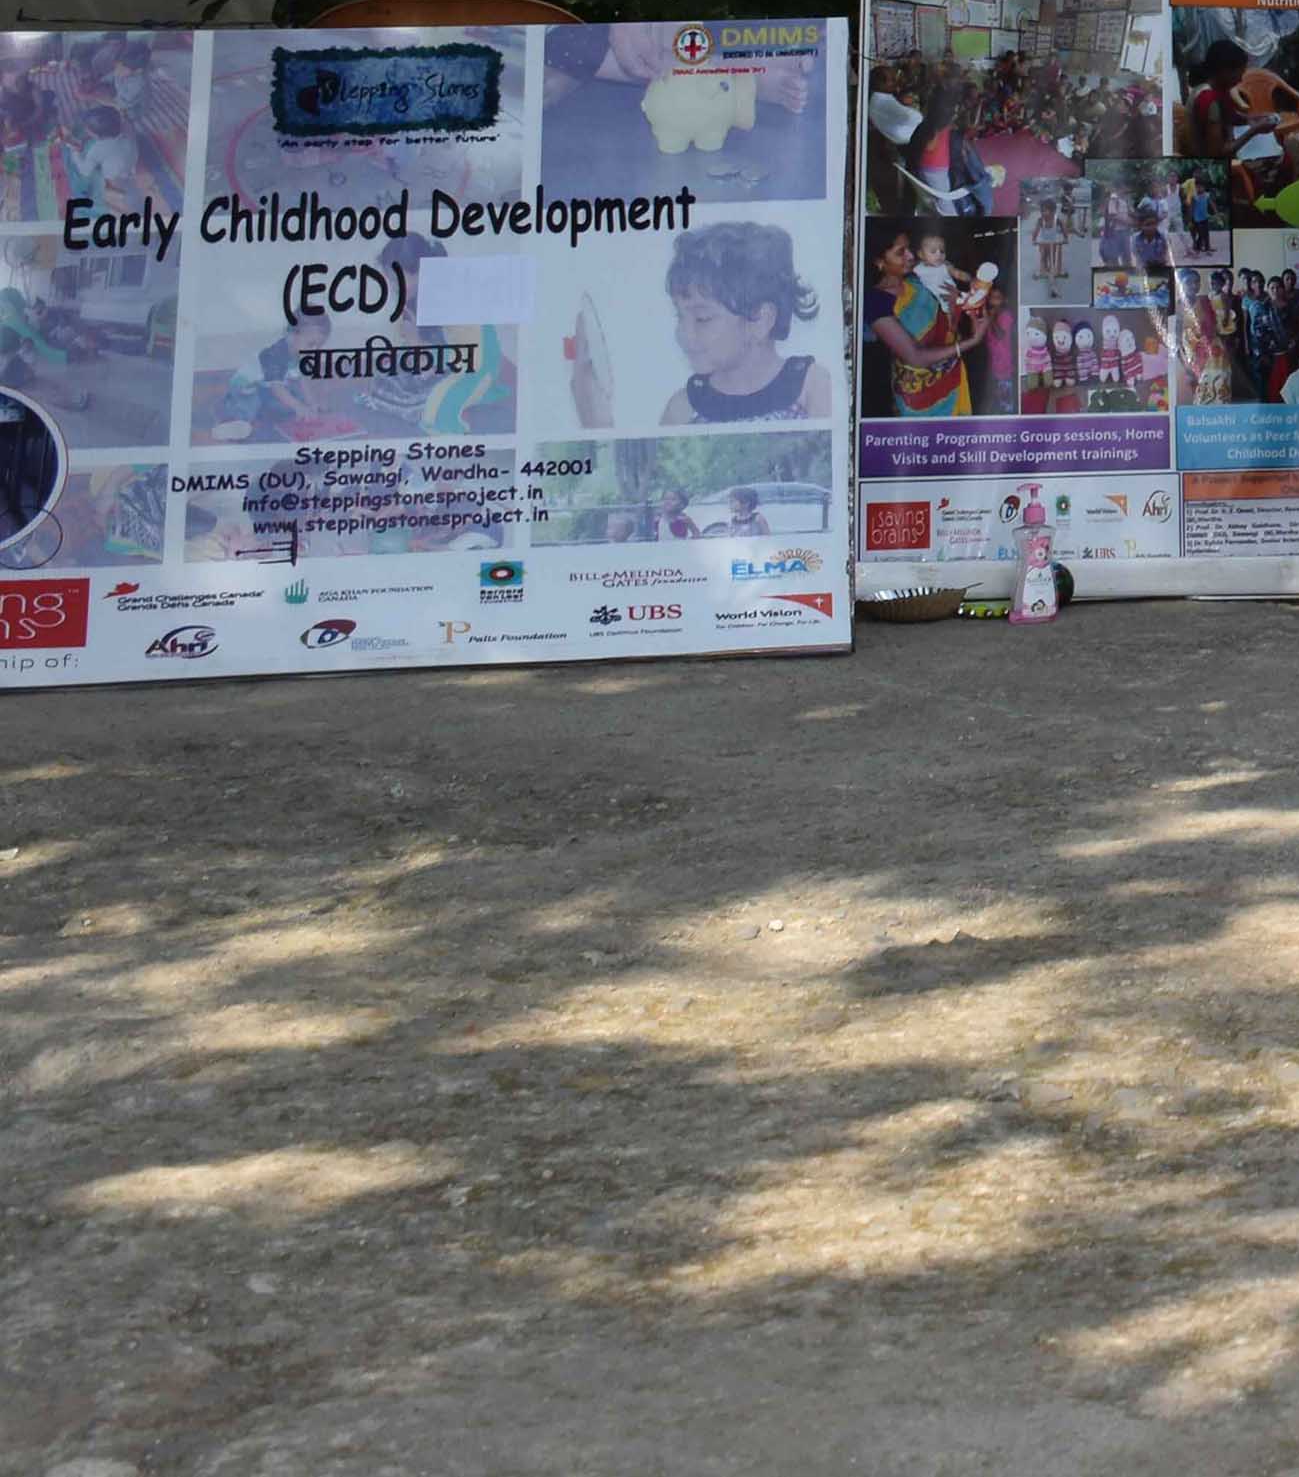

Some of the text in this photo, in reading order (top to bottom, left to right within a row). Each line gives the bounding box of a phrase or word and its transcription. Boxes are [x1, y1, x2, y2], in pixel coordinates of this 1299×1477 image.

[722, 25, 819, 46] DMIMS
[324, 72, 479, 113] Stepping Stones
[303, 140, 338, 149] early
[343, 139, 372, 148] step
[380, 137, 399, 146] for
[406, 136, 449, 145] better
[64, 184, 696, 261] Early Childhood Development
[283, 261, 406, 326] (ECD)
[299, 335, 478, 379] बालविकास
[1286, 411, 1298, 424] of
[865, 428, 1164, 448] Parenting Programme: Group sessions, Home
[1183, 432, 1247, 444] Volunteers
[1265, 430, 1290, 442] Peer
[294, 442, 486, 468] Stepping Stones
[892, 447, 1138, 465] Visits and Skill Development trainings
[1227, 448, 1286, 460] Childhood
[171, 459, 593, 492] DMIMS (DU), Sawangi, Wardha- 442001
[242, 484, 543, 512] info@steppingstonesproject.in
[877, 508, 926, 537] saving
[569, 572, 600, 581] BILL
[613, 569, 683, 579] MELINDA
[731, 560, 808, 575] ELMA
[602, 579, 648, 588] GATES
[117, 599, 235, 611] Grands Canada
[118, 596, 153, 604] Grand
[155, 593, 217, 602] Challenges
[626, 604, 683, 620] UBS
[715, 609, 802, 620] World Vision
[144, 636, 212, 655] Ahri
[501, 632, 567, 642] Foundation
[45, 653, 79, 670] of:
